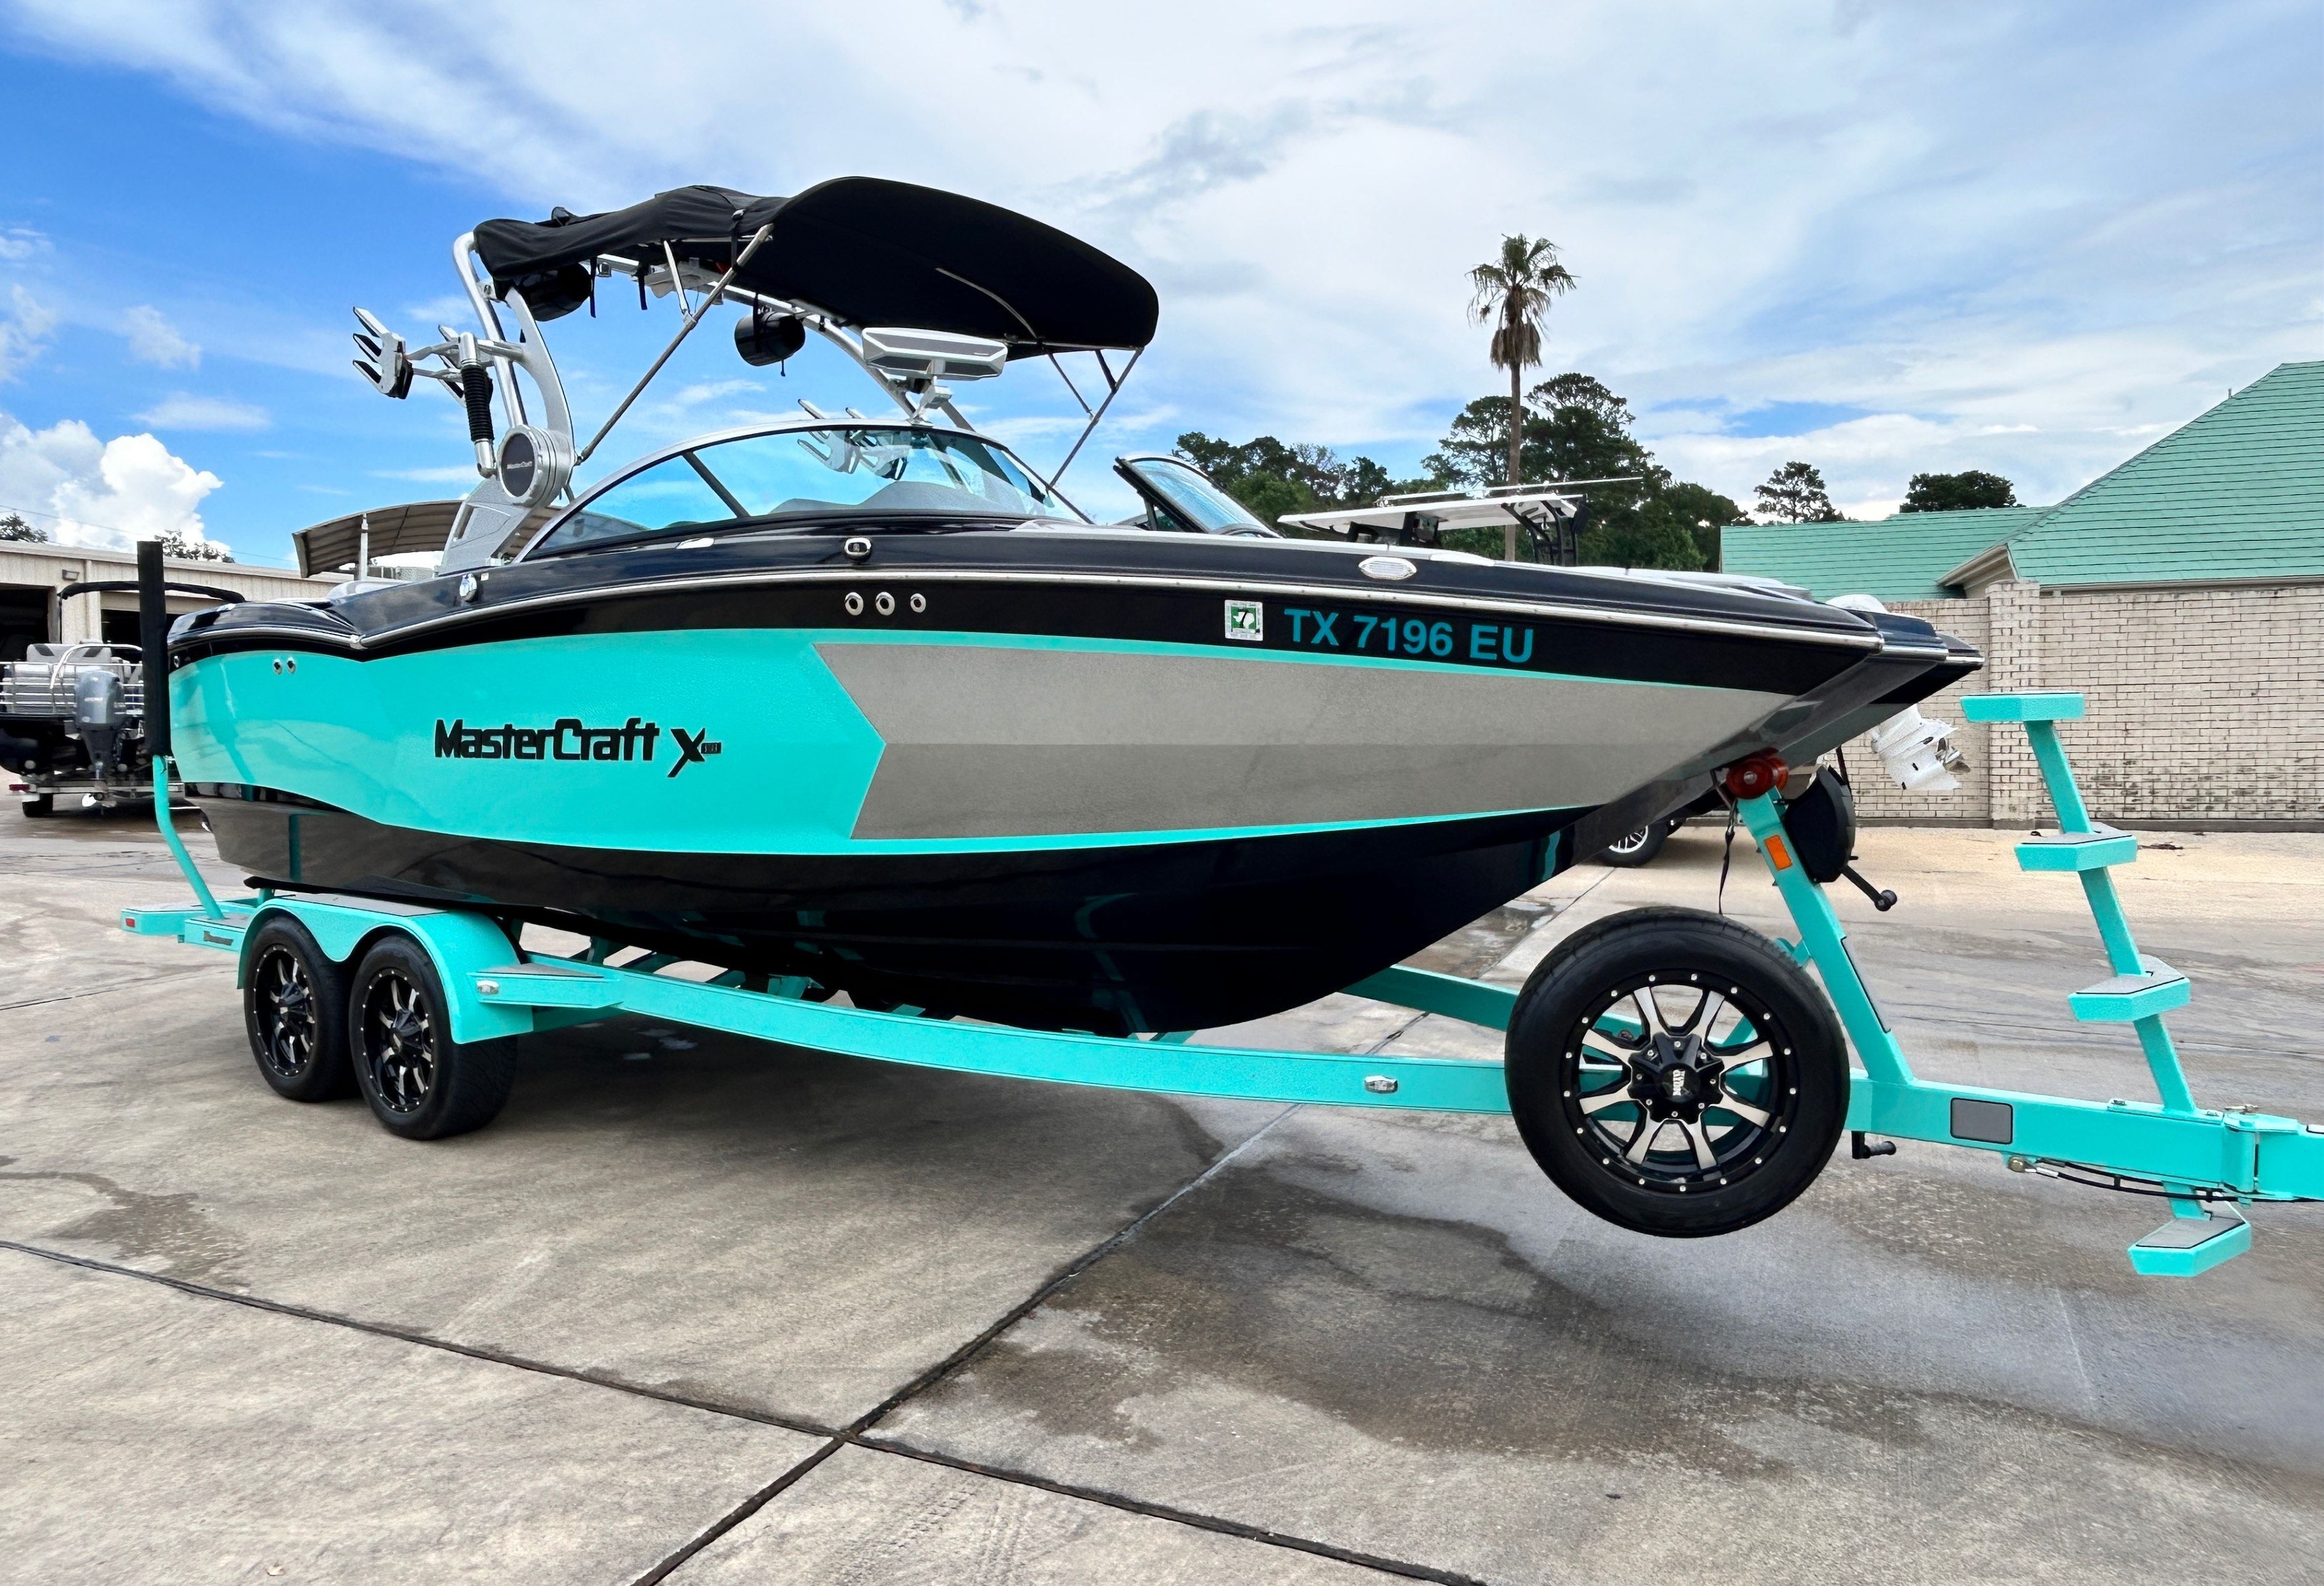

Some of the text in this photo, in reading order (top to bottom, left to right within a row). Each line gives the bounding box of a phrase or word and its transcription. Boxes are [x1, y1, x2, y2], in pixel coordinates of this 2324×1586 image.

[1284, 609, 1339, 645] TX
[1354, 615, 1453, 656] 7196
[1469, 624, 1533, 662] EU
[435, 718, 659, 760] MasterCraft
